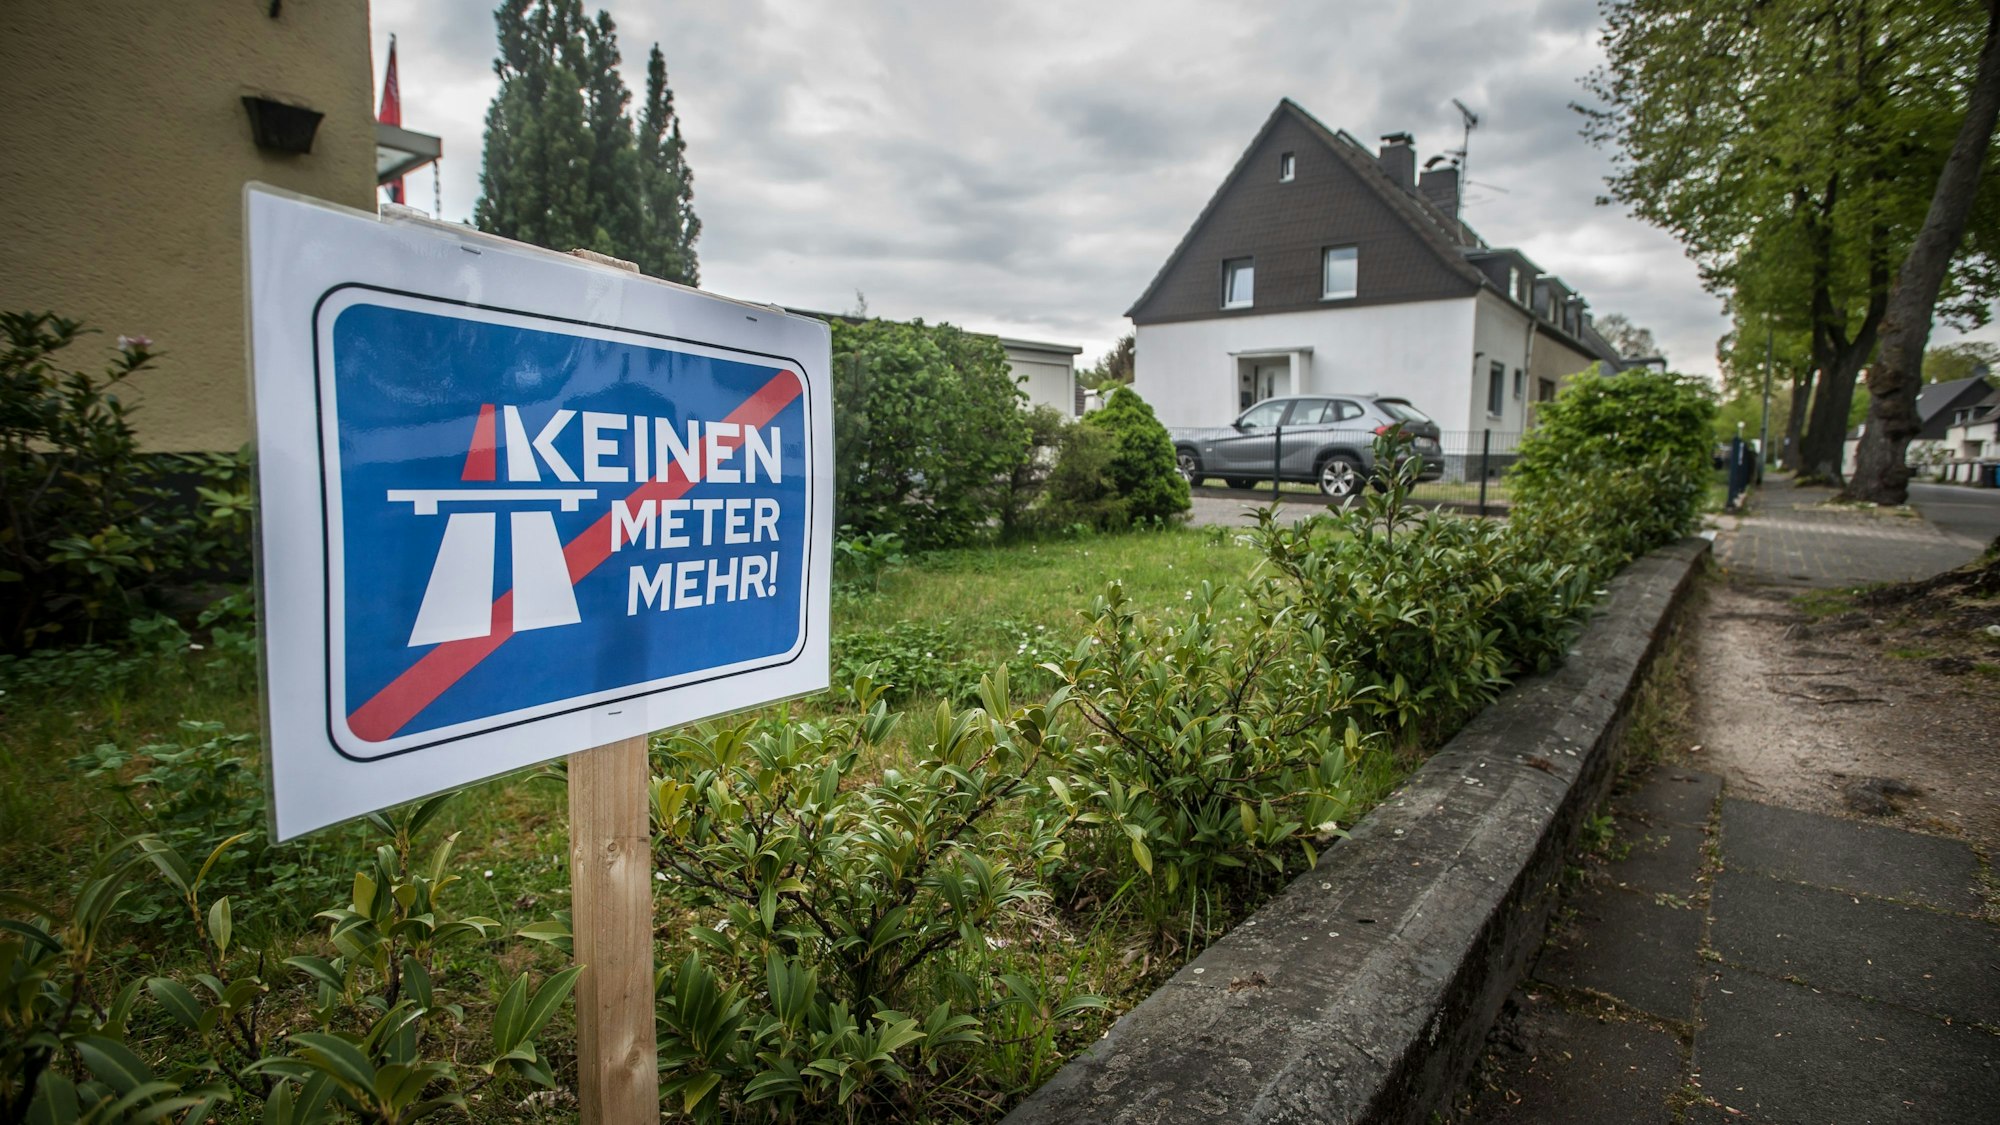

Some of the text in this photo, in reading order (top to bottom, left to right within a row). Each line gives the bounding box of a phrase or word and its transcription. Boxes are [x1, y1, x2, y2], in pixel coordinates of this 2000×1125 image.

[504, 405, 782, 484] KEINEN
[611, 498, 781, 552] METER
[627, 551, 779, 616] MEHR!
